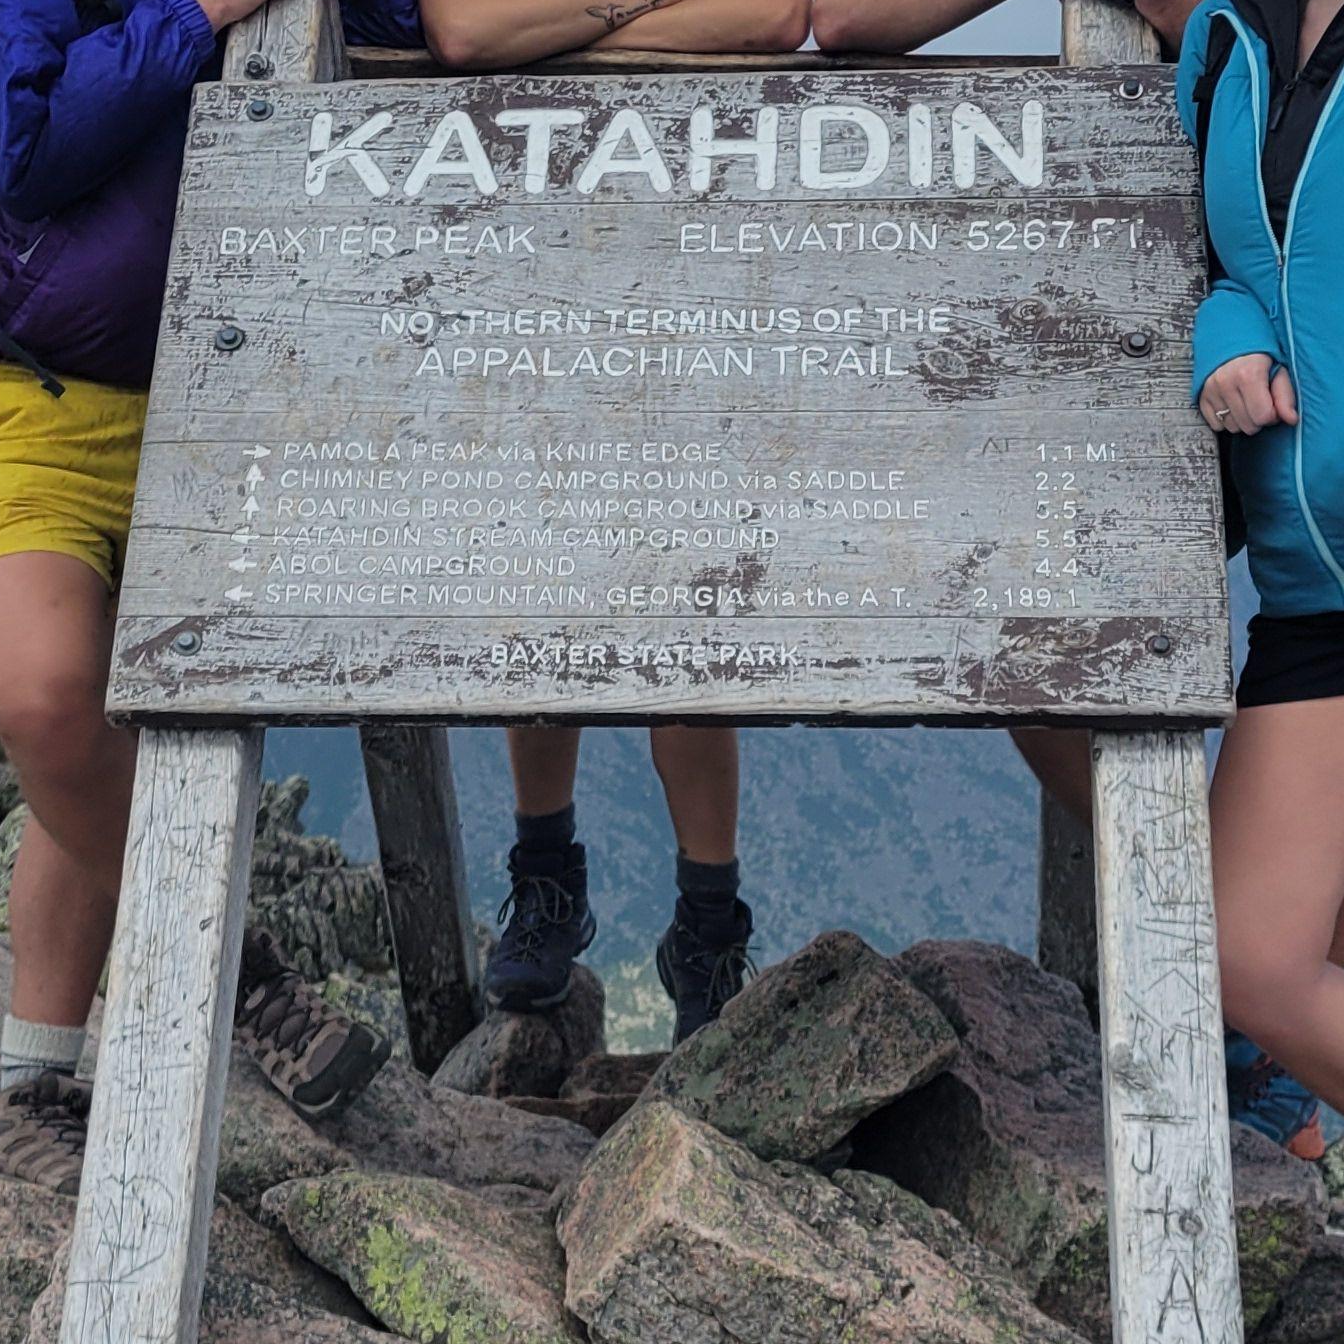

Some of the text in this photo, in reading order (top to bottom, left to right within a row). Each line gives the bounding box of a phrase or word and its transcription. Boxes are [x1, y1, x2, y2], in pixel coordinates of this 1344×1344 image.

[303, 99, 1044, 197] KATAHDIN
[219, 217, 1153, 255] BAXTER PEAK ELEVATION 5267 FT.
[604, 308, 802, 336] TERMINUS
[811, 307, 864, 334] OF
[874, 306, 951, 333] THE
[414, 345, 909, 378] APPALACHIAN TRAIL
[282, 441, 401, 461] PAMOLA
[411, 441, 488, 461] PEAK
[497, 441, 536, 462] via
[546, 442, 632, 462] KNIFE
[641, 442, 722, 463] EDGE
[1036, 443, 1072, 462] 1.1
[280, 468, 1076, 491] CHIMNEY POND CAMPGROUND via SADDLE 2.2
[276, 497, 1077, 520] ROARING BROOK CAMPGROUND via SADDLE 5.5
[272, 525, 1077, 549] KATAHDIN STREAM CAMPGROUND 5.5
[267, 555, 1079, 577] ABOL CAMPGROUND 4.4
[264, 583, 417, 605] SPRINGER
[427, 584, 595, 609] MOUNTAIN,
[606, 585, 745, 607] GEORGIA
[756, 587, 796, 607] via
[803, 587, 850, 607] the
[973, 587, 1076, 611] 2,189.1
[491, 642, 799, 667] BAXTER STATE PARK
